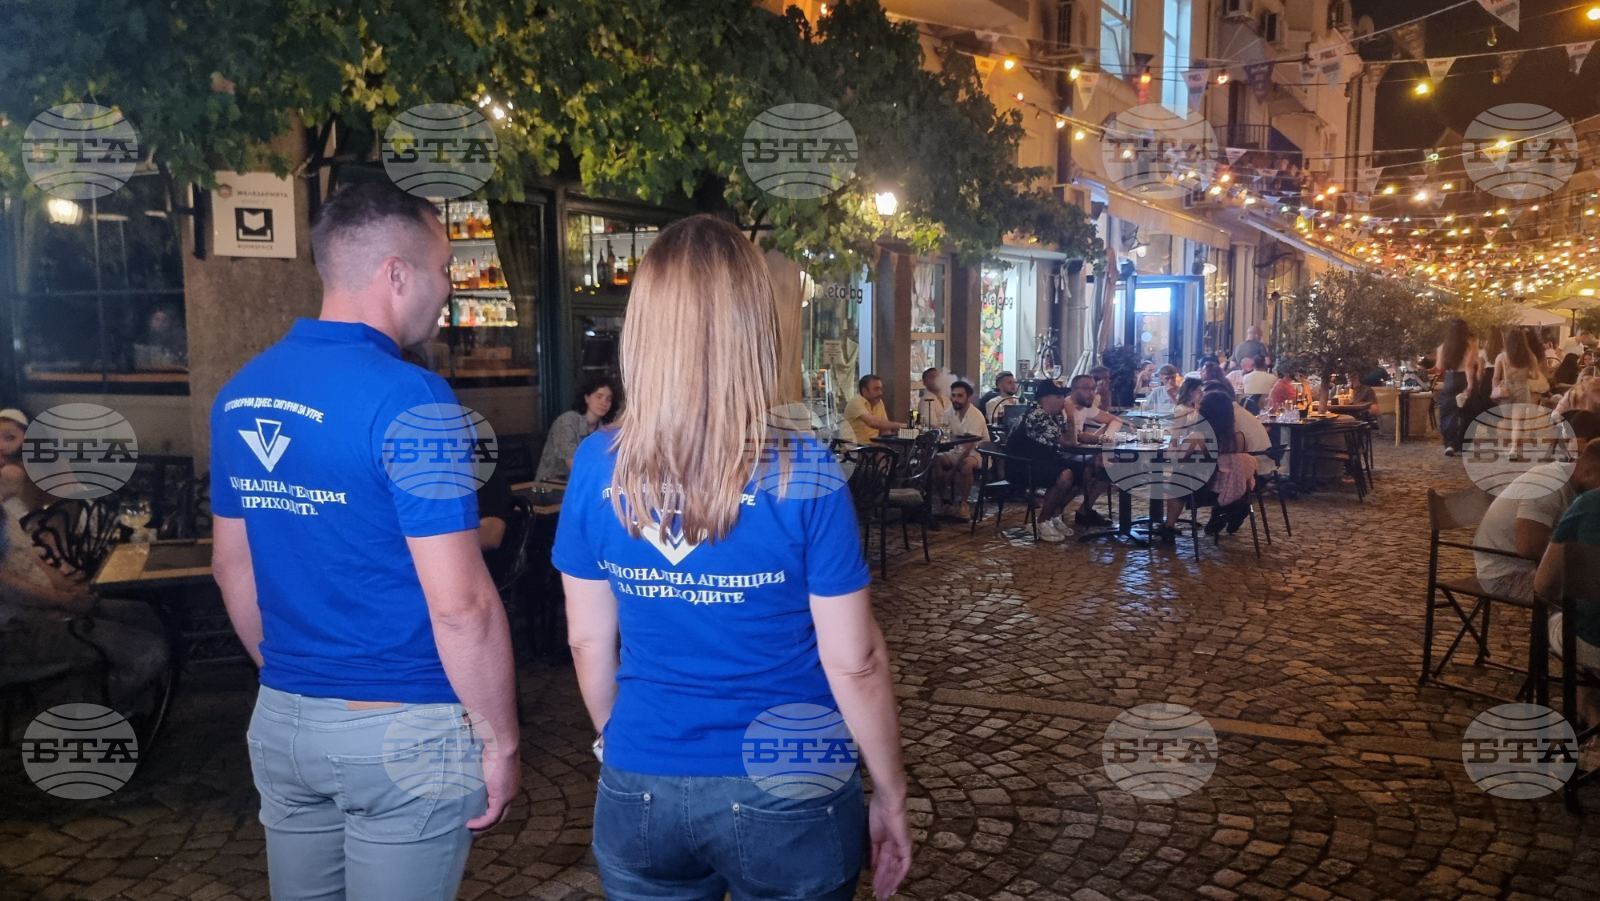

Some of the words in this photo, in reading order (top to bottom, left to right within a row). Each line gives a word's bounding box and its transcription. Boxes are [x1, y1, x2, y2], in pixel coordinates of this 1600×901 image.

[698, 570, 786, 589] АГЕНЦИЯ
[617, 581, 636, 595] ЗА
[635, 585, 746, 606] ПРИХОДИТЕ
